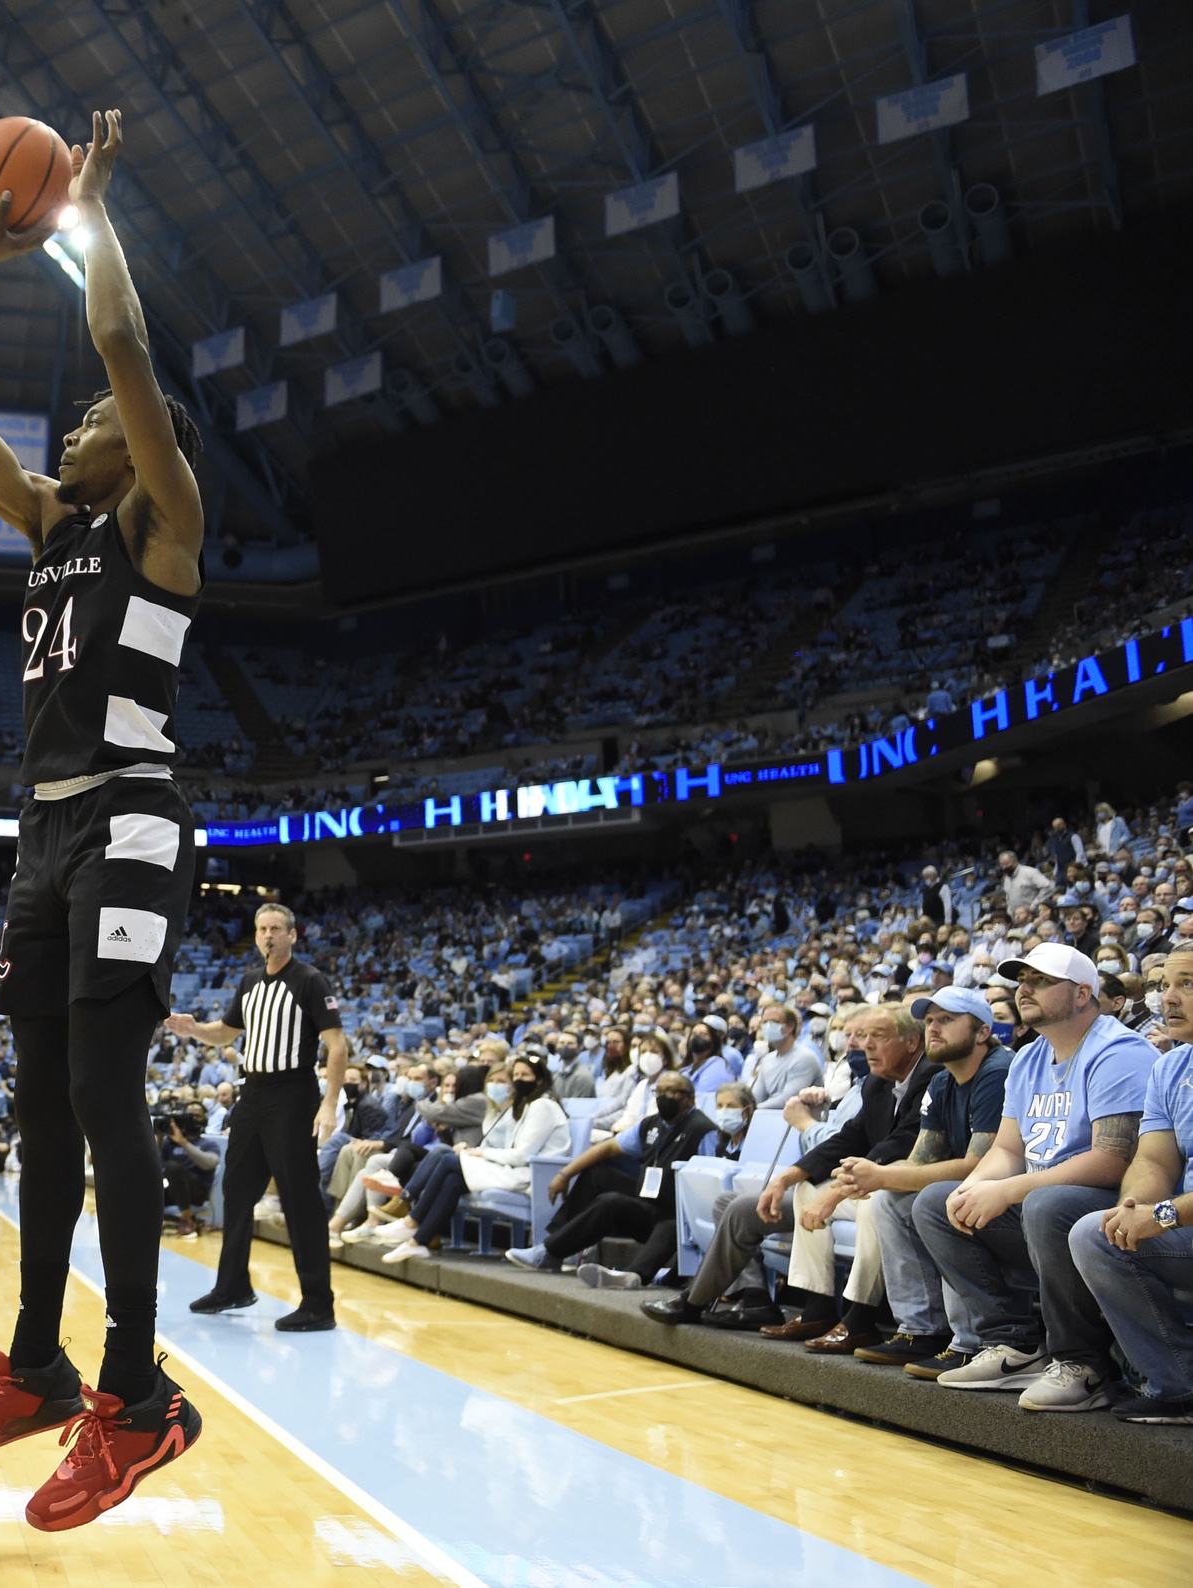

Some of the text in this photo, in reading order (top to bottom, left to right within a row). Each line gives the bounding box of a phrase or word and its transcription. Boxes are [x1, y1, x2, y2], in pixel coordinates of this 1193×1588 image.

[28, 556, 102, 588] USVILLE
[22, 595, 78, 683] 24
[827, 718, 939, 785] UNC
[757, 762, 821, 782] HEALTH
[208, 825, 278, 839] UNC HEALTH
[107, 935, 132, 943] adidas
[1024, 1119, 1067, 1161] 23
